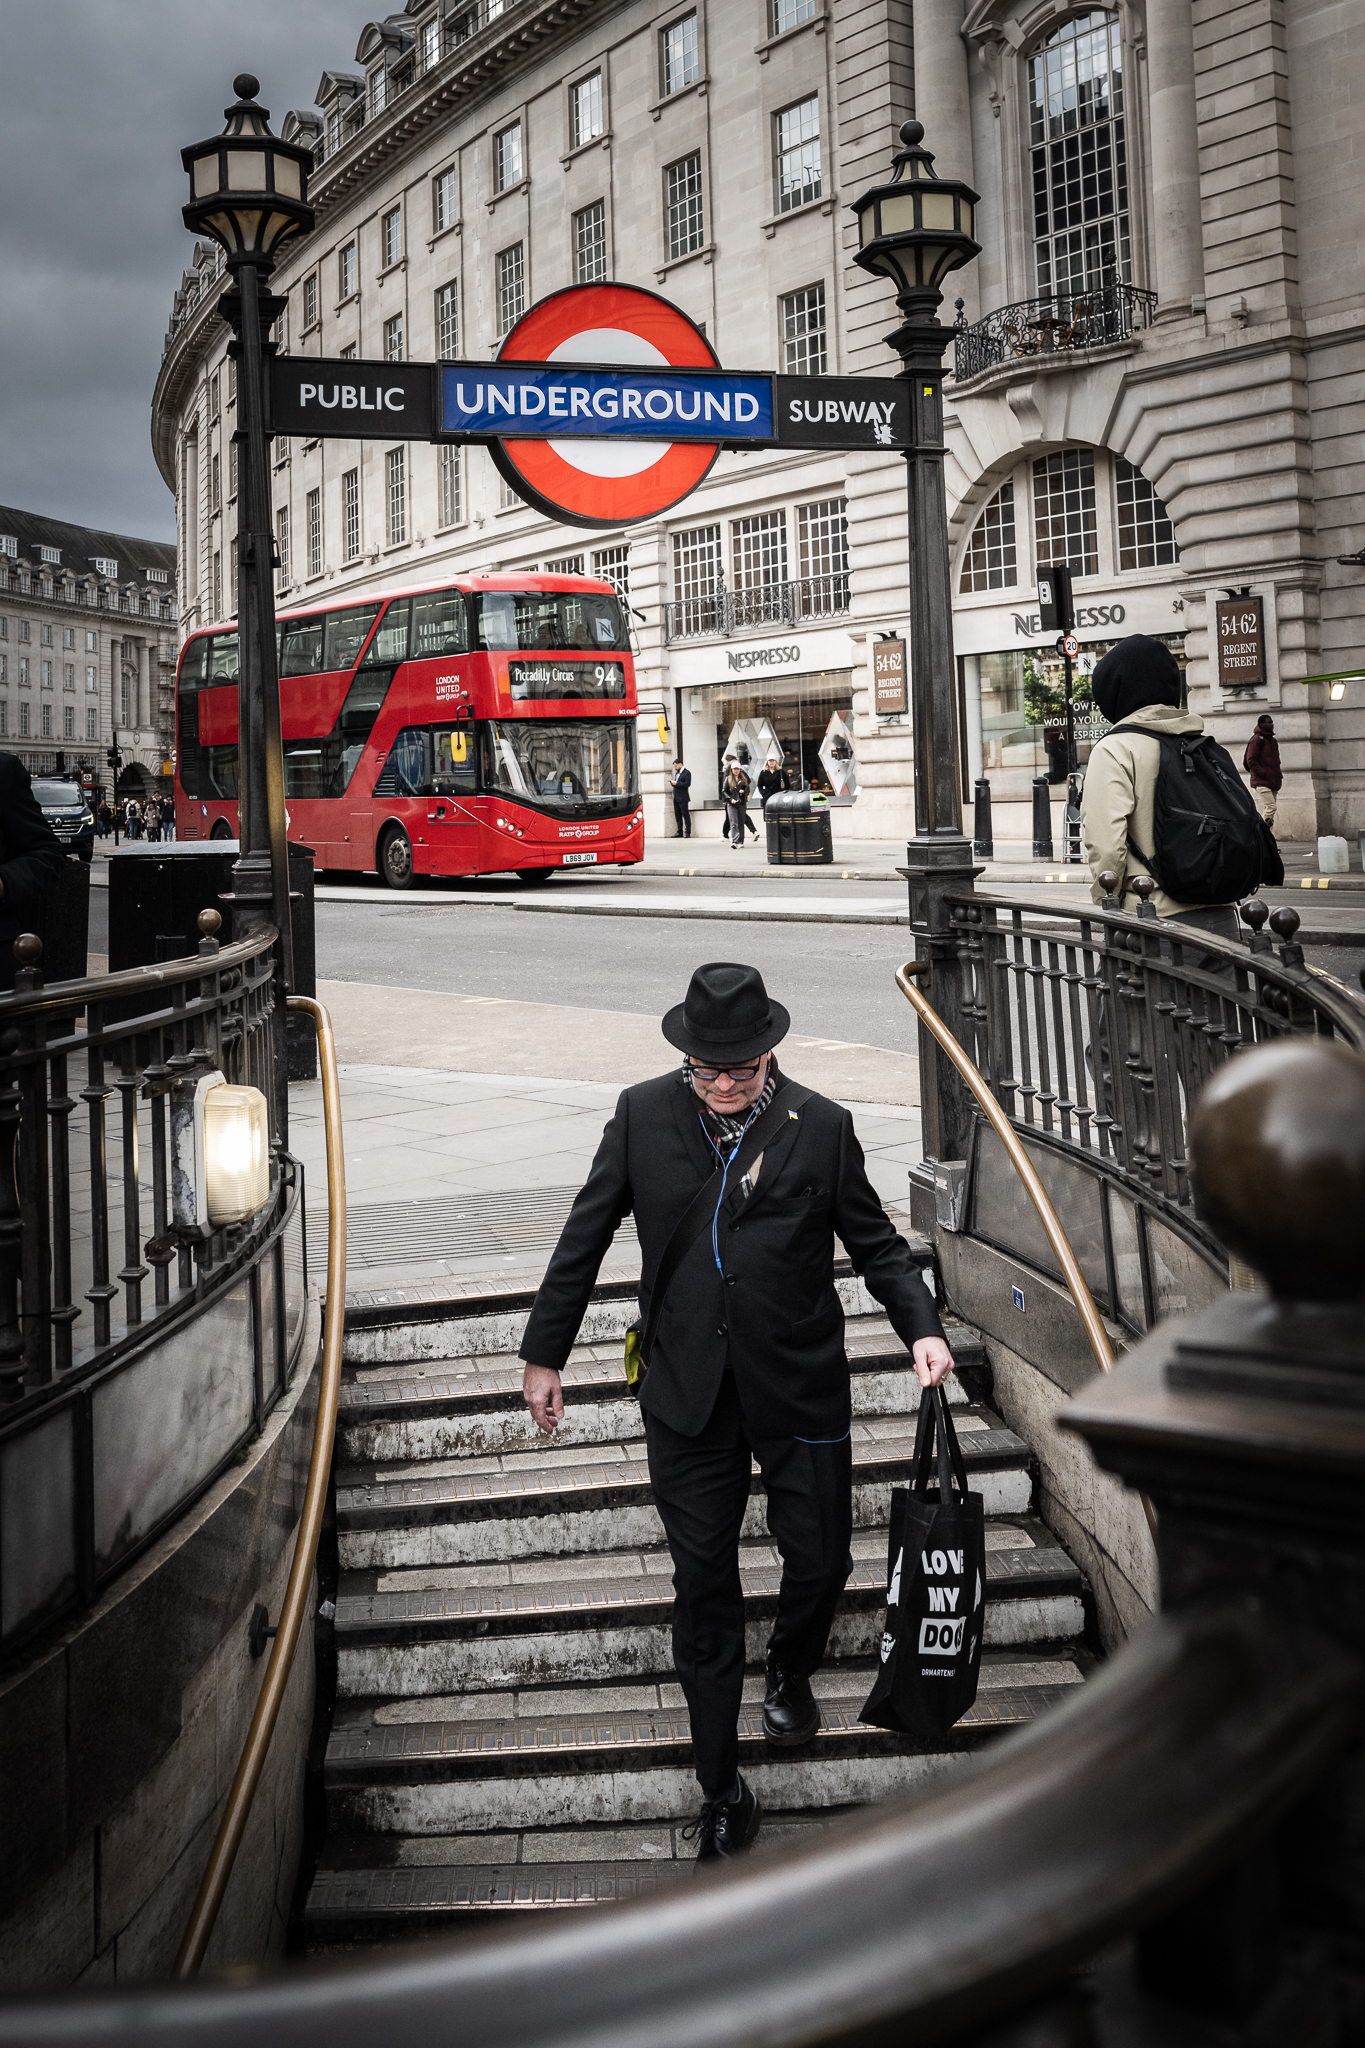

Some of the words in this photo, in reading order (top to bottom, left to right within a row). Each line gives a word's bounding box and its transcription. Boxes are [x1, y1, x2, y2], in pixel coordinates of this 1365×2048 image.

[300, 383, 405, 411] PUBLIC
[456, 383, 759, 422] UNDERGROUND
[789, 399, 896, 424] SUBWAY
[1011, 604, 1125, 637] NEESSO
[1221, 612, 1257, 636] 54-62
[1067, 641, 1077, 651] 20
[1223, 642, 1257, 655] REGENT
[725, 645, 800, 672] NESPRESSO
[876, 652, 902, 672] 54-62
[1223, 655, 1258, 668] STREET
[435, 675, 460, 685] LONDON
[515, 667, 550, 684] Piccadilly
[552, 667, 575, 681] Circus
[595, 666, 616, 686] 94
[878, 677, 902, 688] REGENT
[435, 684, 460, 694] UNITED
[878, 688, 902, 699] STREET
[1072, 702, 1089, 712] OW
[1078, 715, 1098, 725] YOU
[927, 1586, 960, 1612] MY
